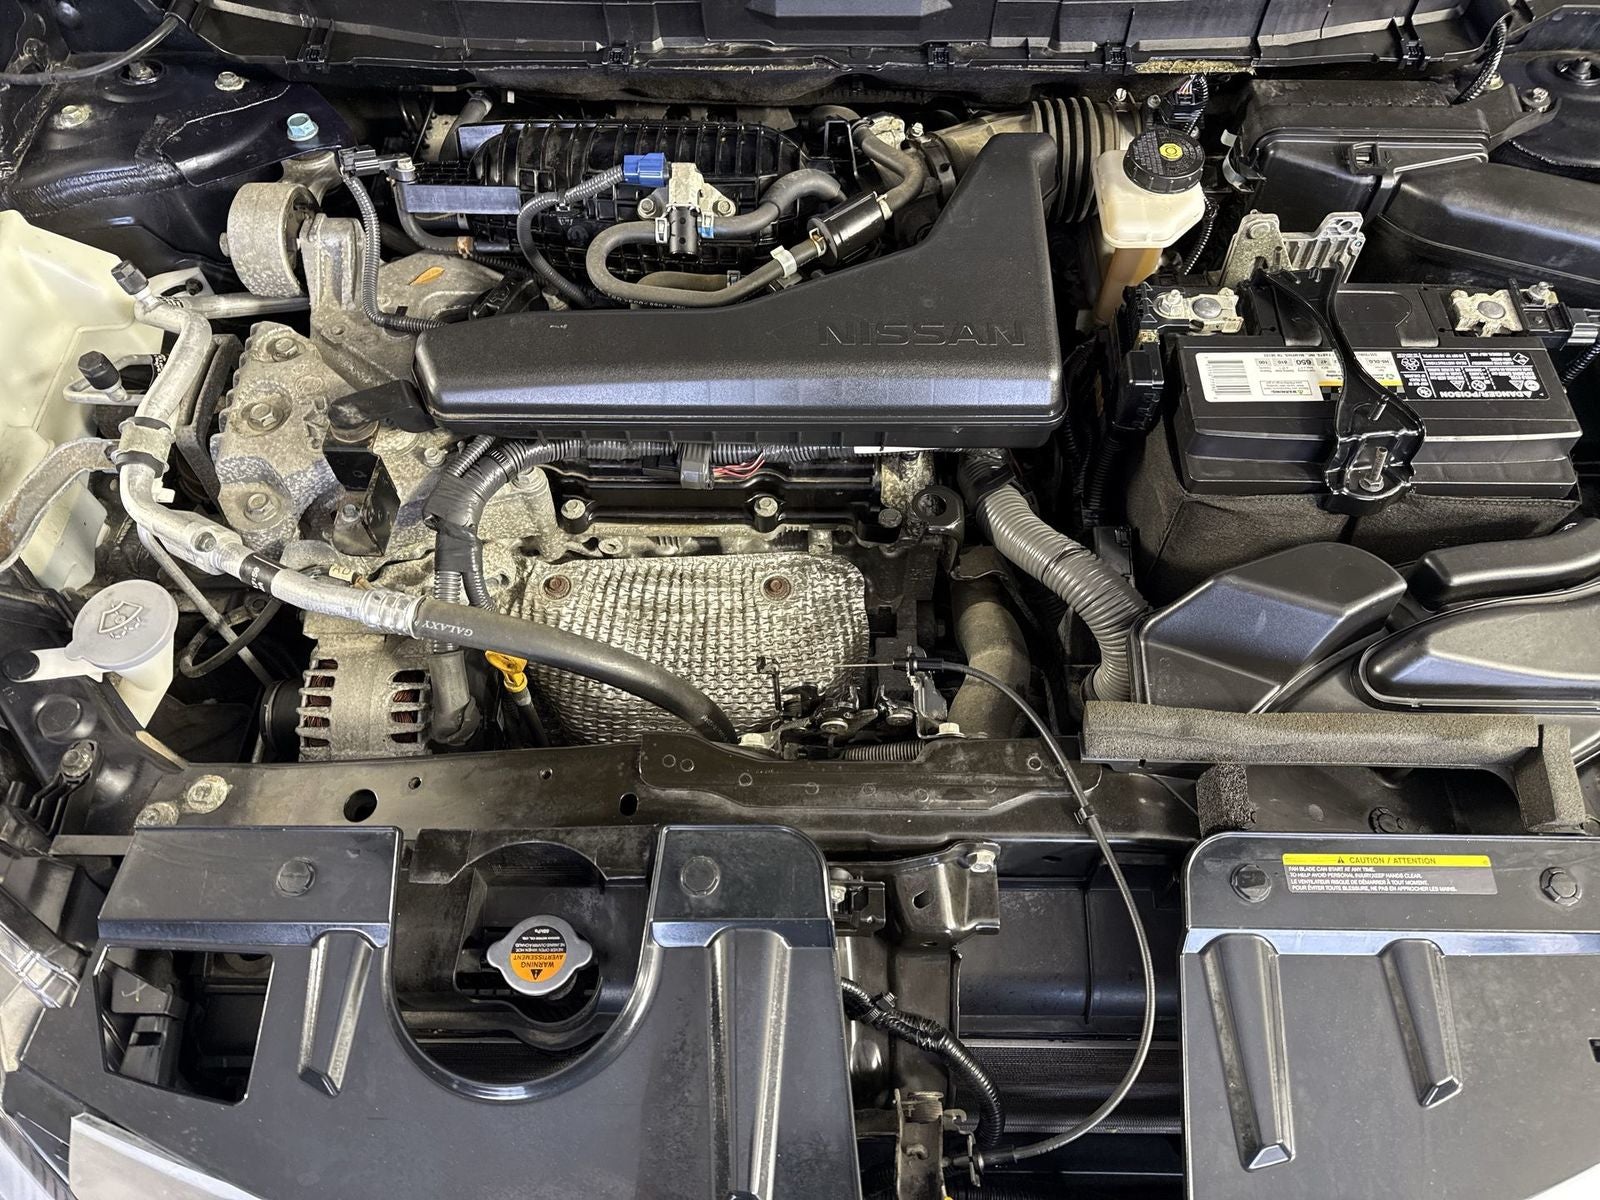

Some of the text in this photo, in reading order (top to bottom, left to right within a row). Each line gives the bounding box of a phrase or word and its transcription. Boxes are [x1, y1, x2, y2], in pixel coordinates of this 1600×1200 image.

[819, 321, 1026, 346] NISSAN
[421, 620, 474, 637] GALAXY
[1349, 856, 1385, 864] CAUTION
[1393, 857, 1437, 865] ATTENTION
